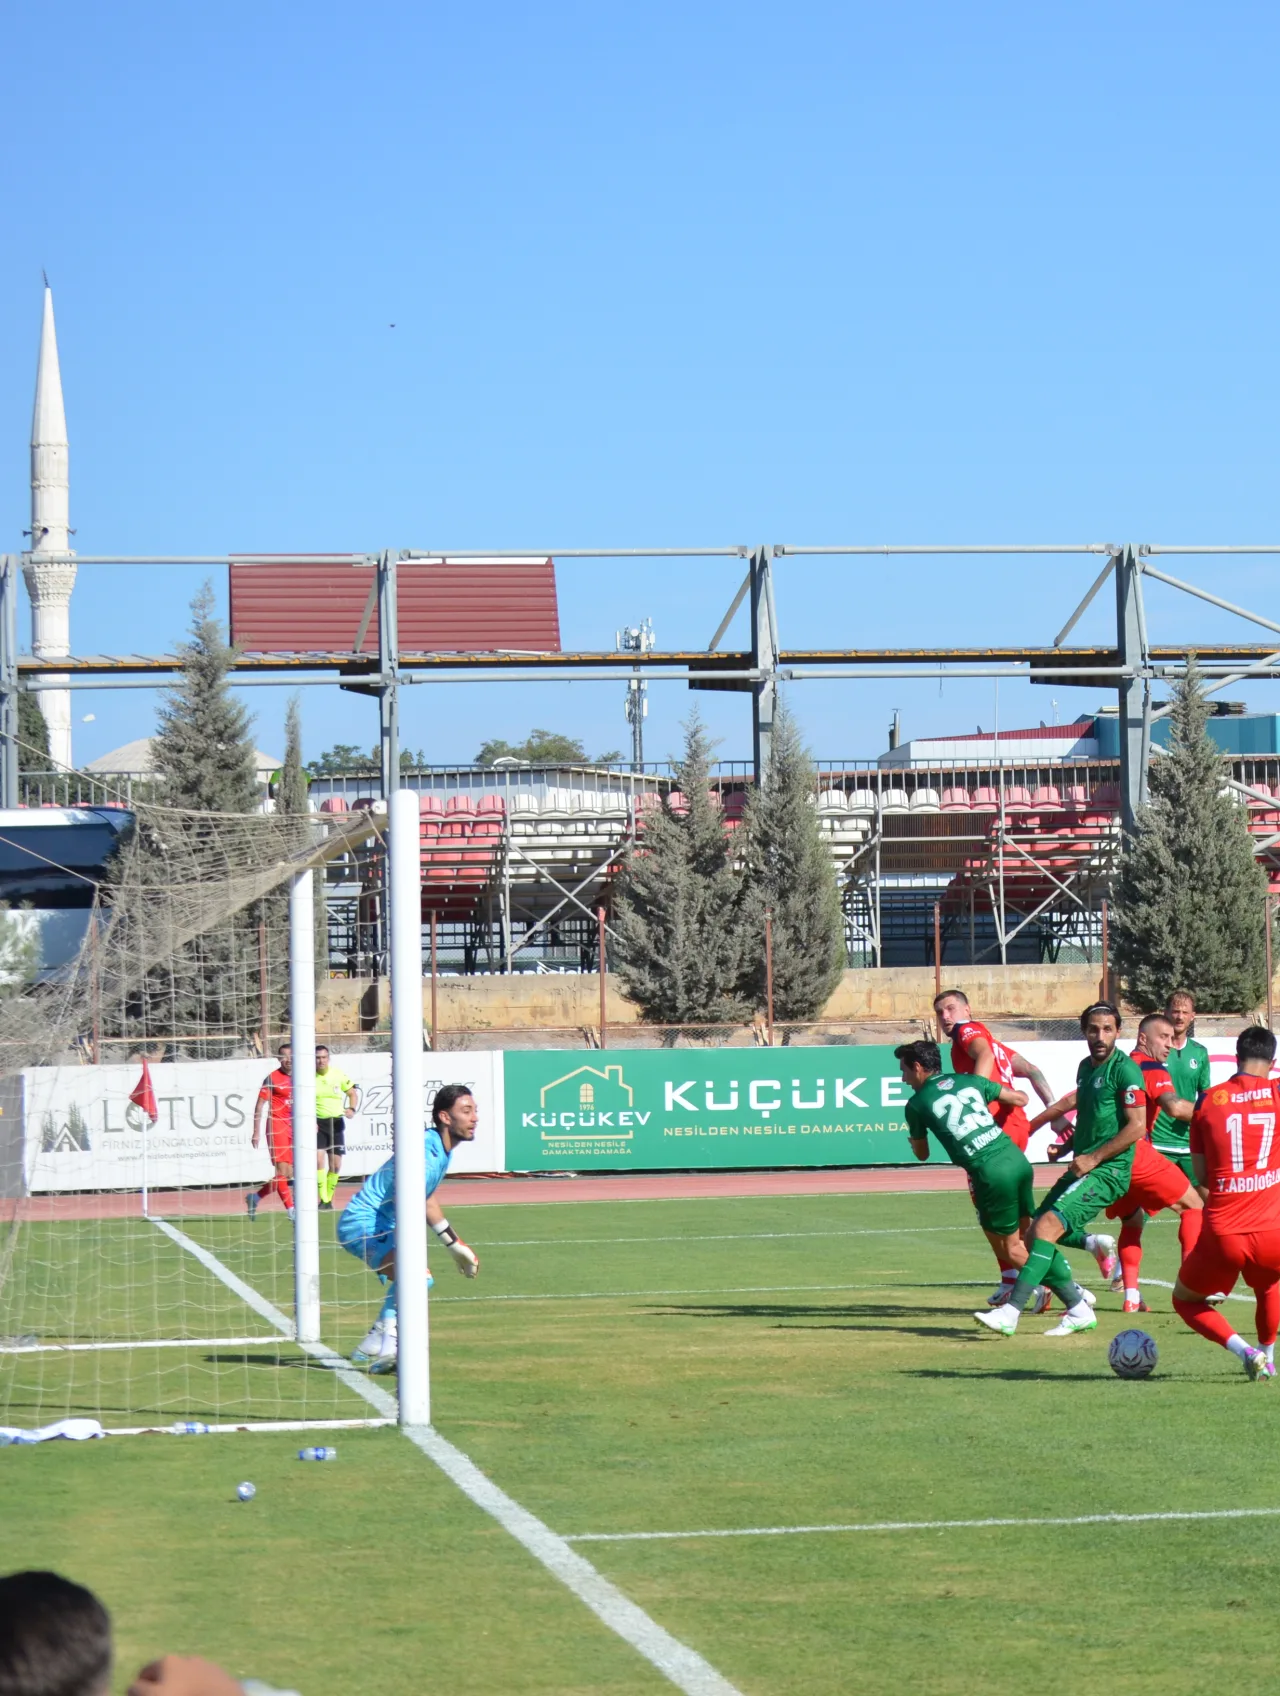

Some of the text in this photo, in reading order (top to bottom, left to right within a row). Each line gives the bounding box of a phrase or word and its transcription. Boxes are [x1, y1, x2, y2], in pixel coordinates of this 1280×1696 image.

[102, 1093, 246, 1133] LOTUS
[579, 1103, 595, 1111] 1976
[664, 1076, 909, 1119] KÜÇÜKE
[932, 1087, 995, 1141] 23
[522, 1111, 652, 1131] KÜÇÜKEV
[663, 1125, 739, 1136] NESİLDEN
[743, 1123, 796, 1135] NESİLE
[800, 1122, 884, 1134] DAMAKTAN
[1226, 1112, 1276, 1173] 17
